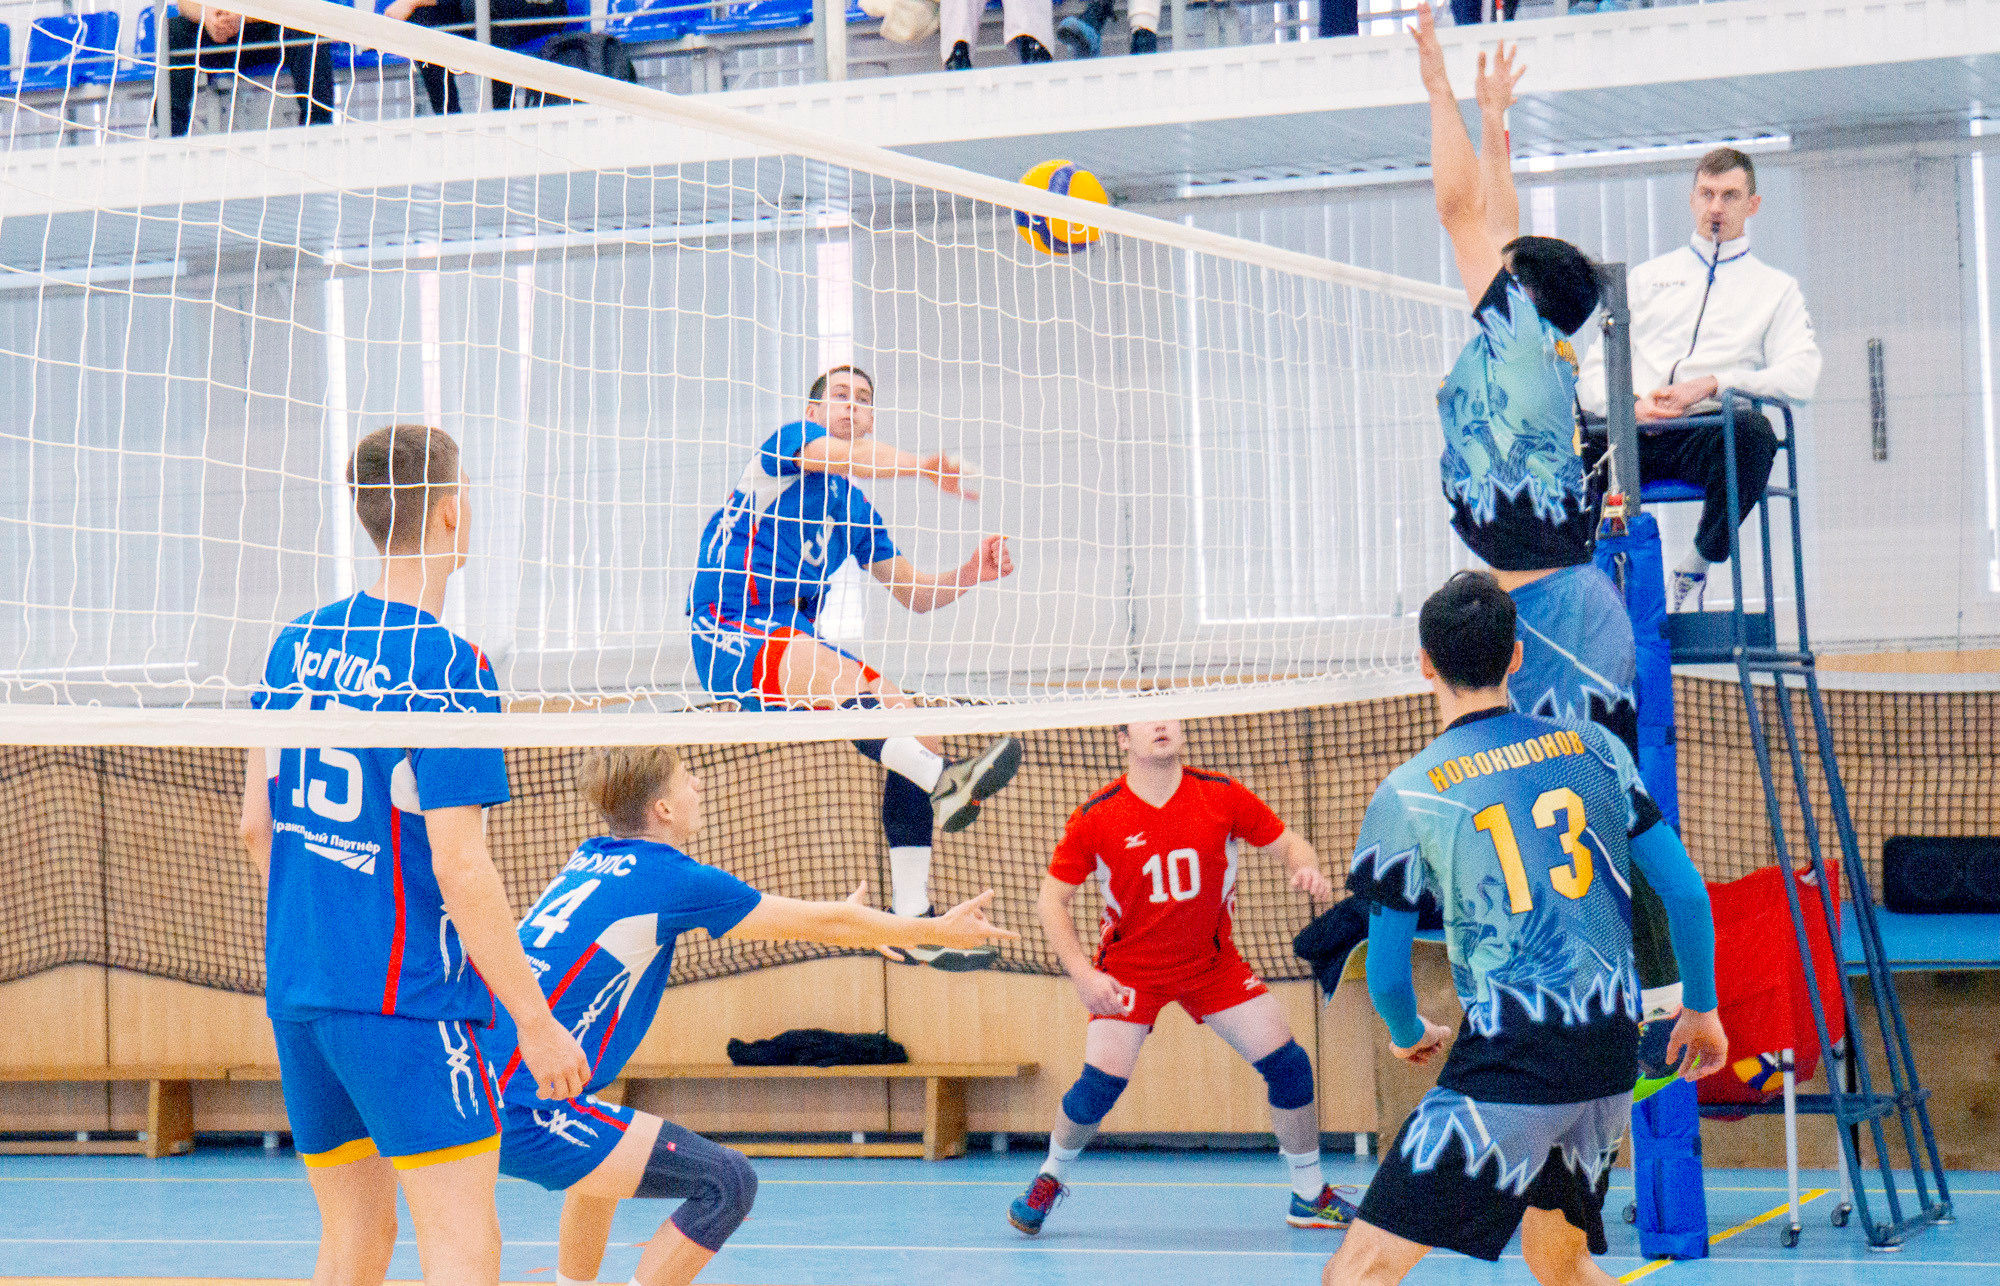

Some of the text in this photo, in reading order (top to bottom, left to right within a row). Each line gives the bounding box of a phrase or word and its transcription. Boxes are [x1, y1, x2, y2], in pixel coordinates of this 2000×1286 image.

[289, 692, 363, 822] 15
[1427, 730, 1585, 793] НОВОКШОНОВ
[1142, 847, 1201, 903] 10
[1472, 787, 1594, 914] 13
